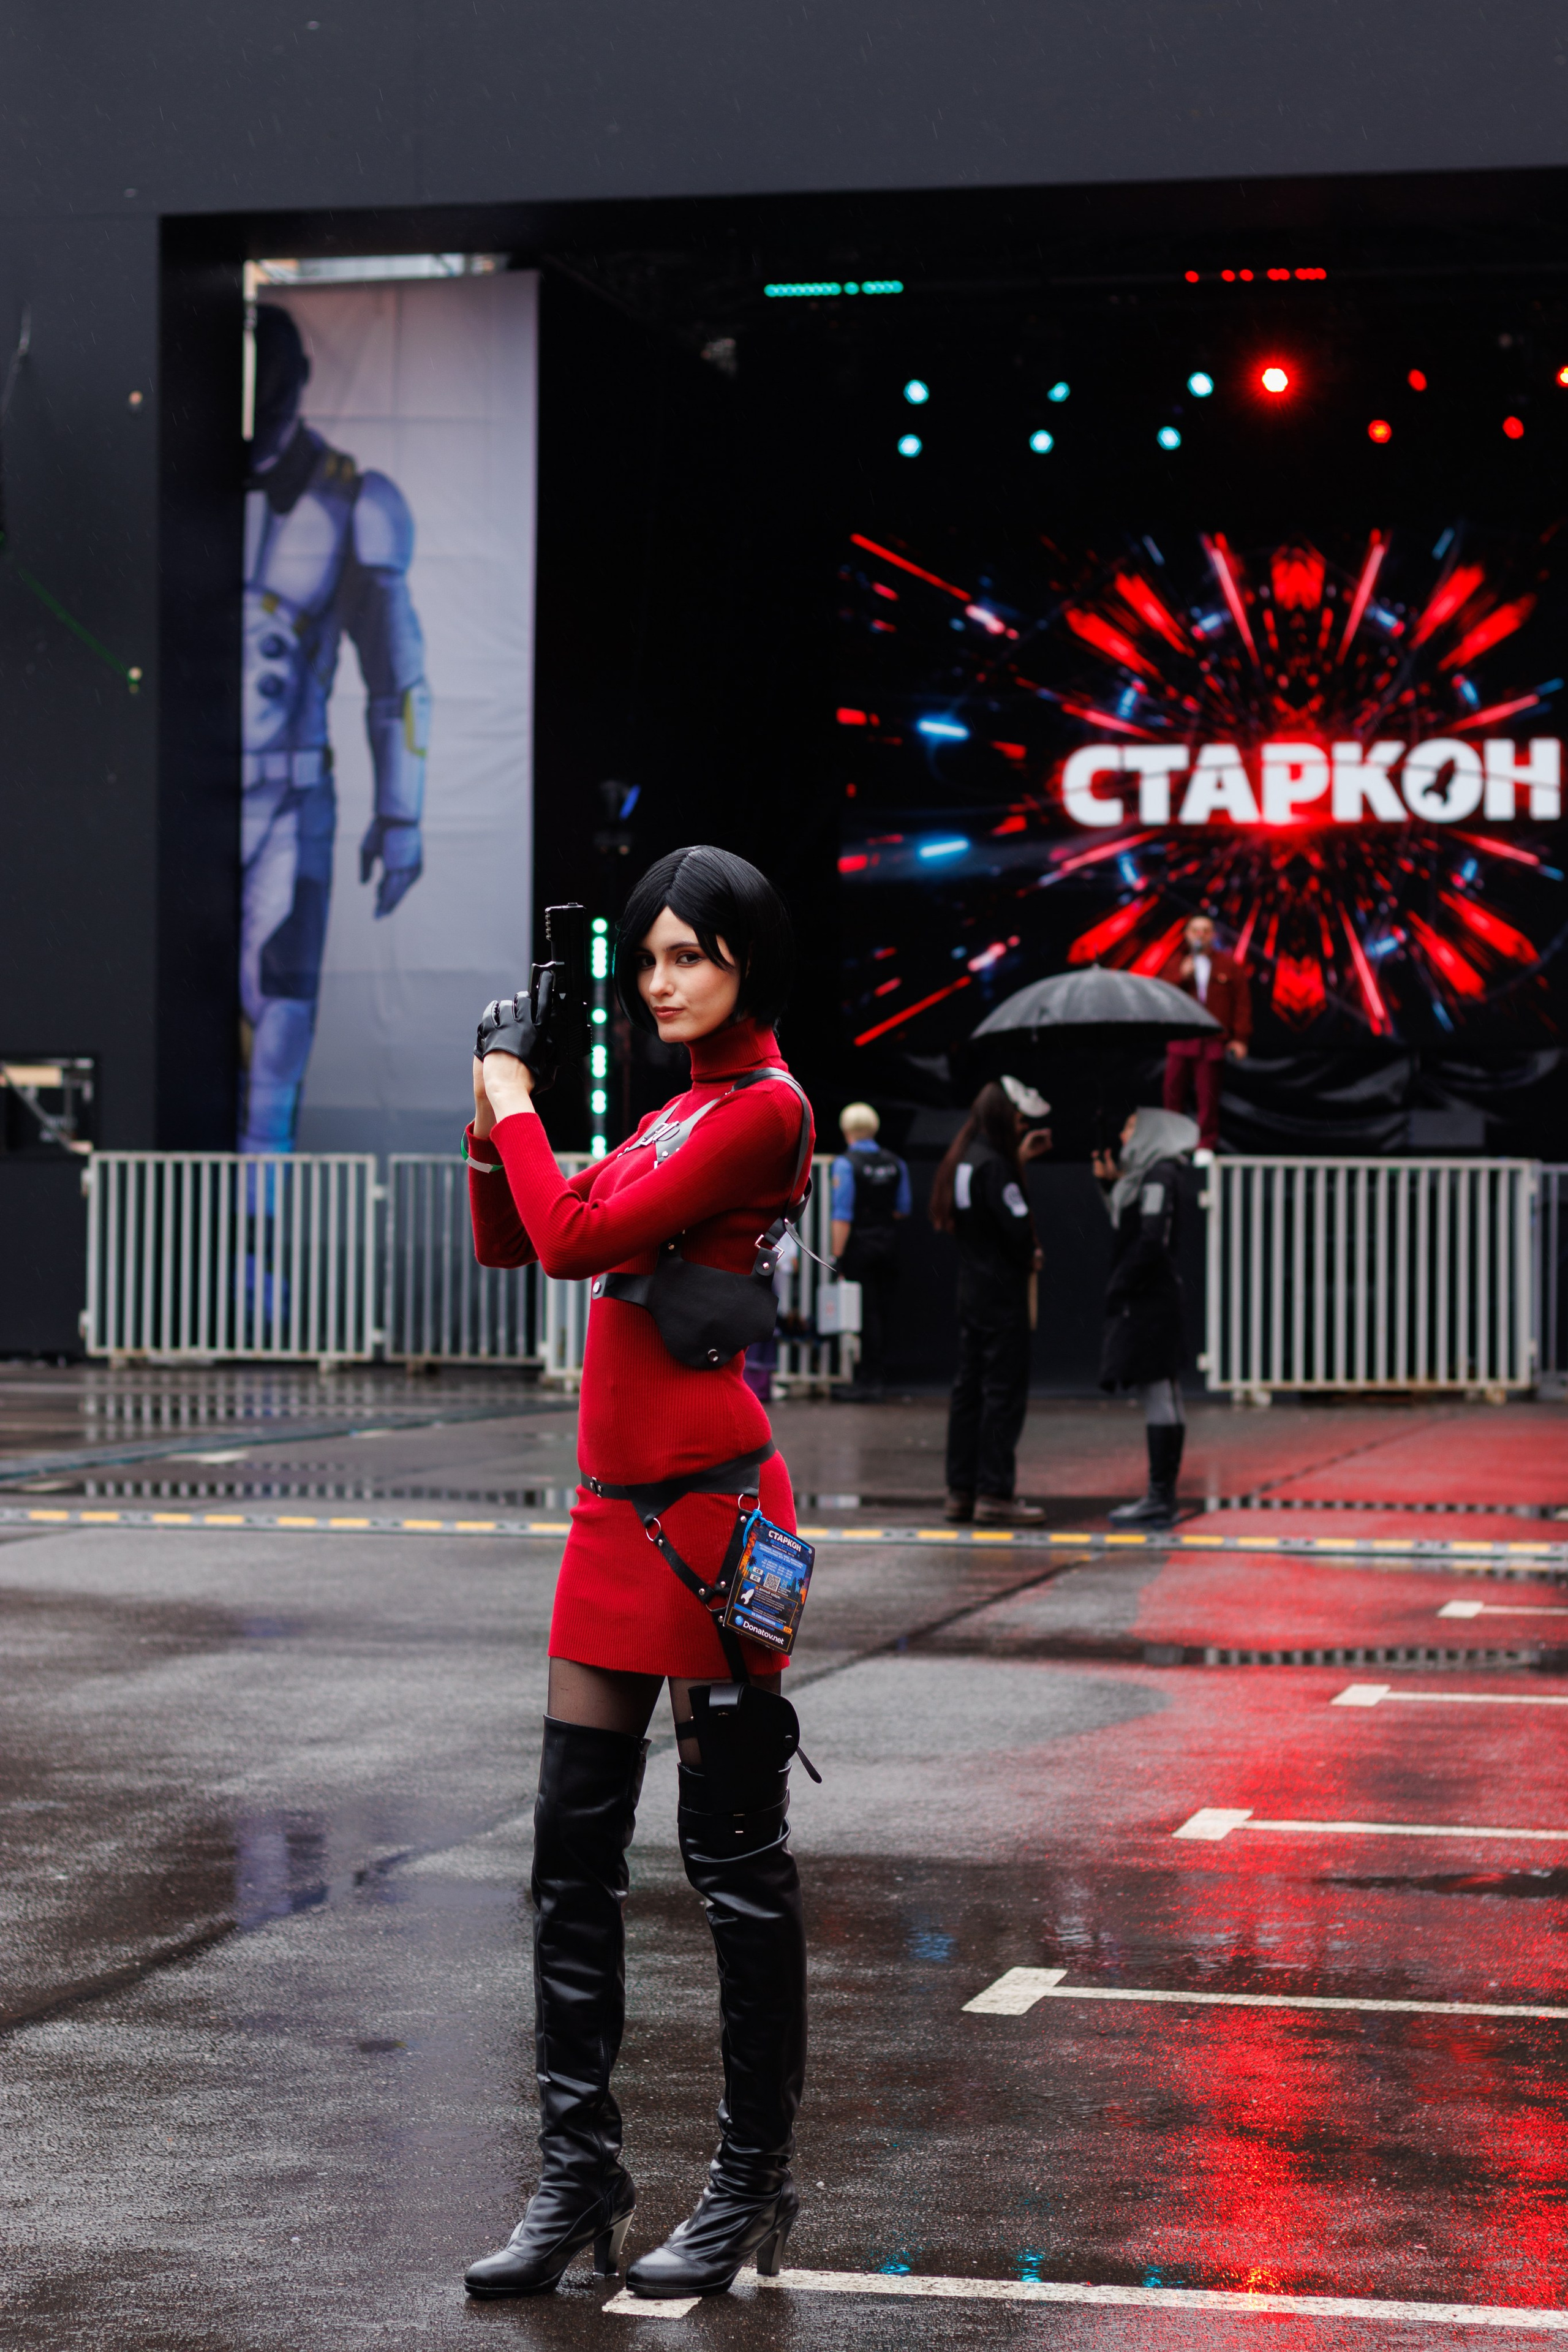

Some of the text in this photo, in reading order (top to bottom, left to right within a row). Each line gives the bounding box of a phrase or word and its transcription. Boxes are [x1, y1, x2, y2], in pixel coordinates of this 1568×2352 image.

[1062, 737, 1561, 827] СТАРКОН
[768, 1530, 802, 1552] СТАРКОН
[742, 1621, 784, 1645] Donatov.net
